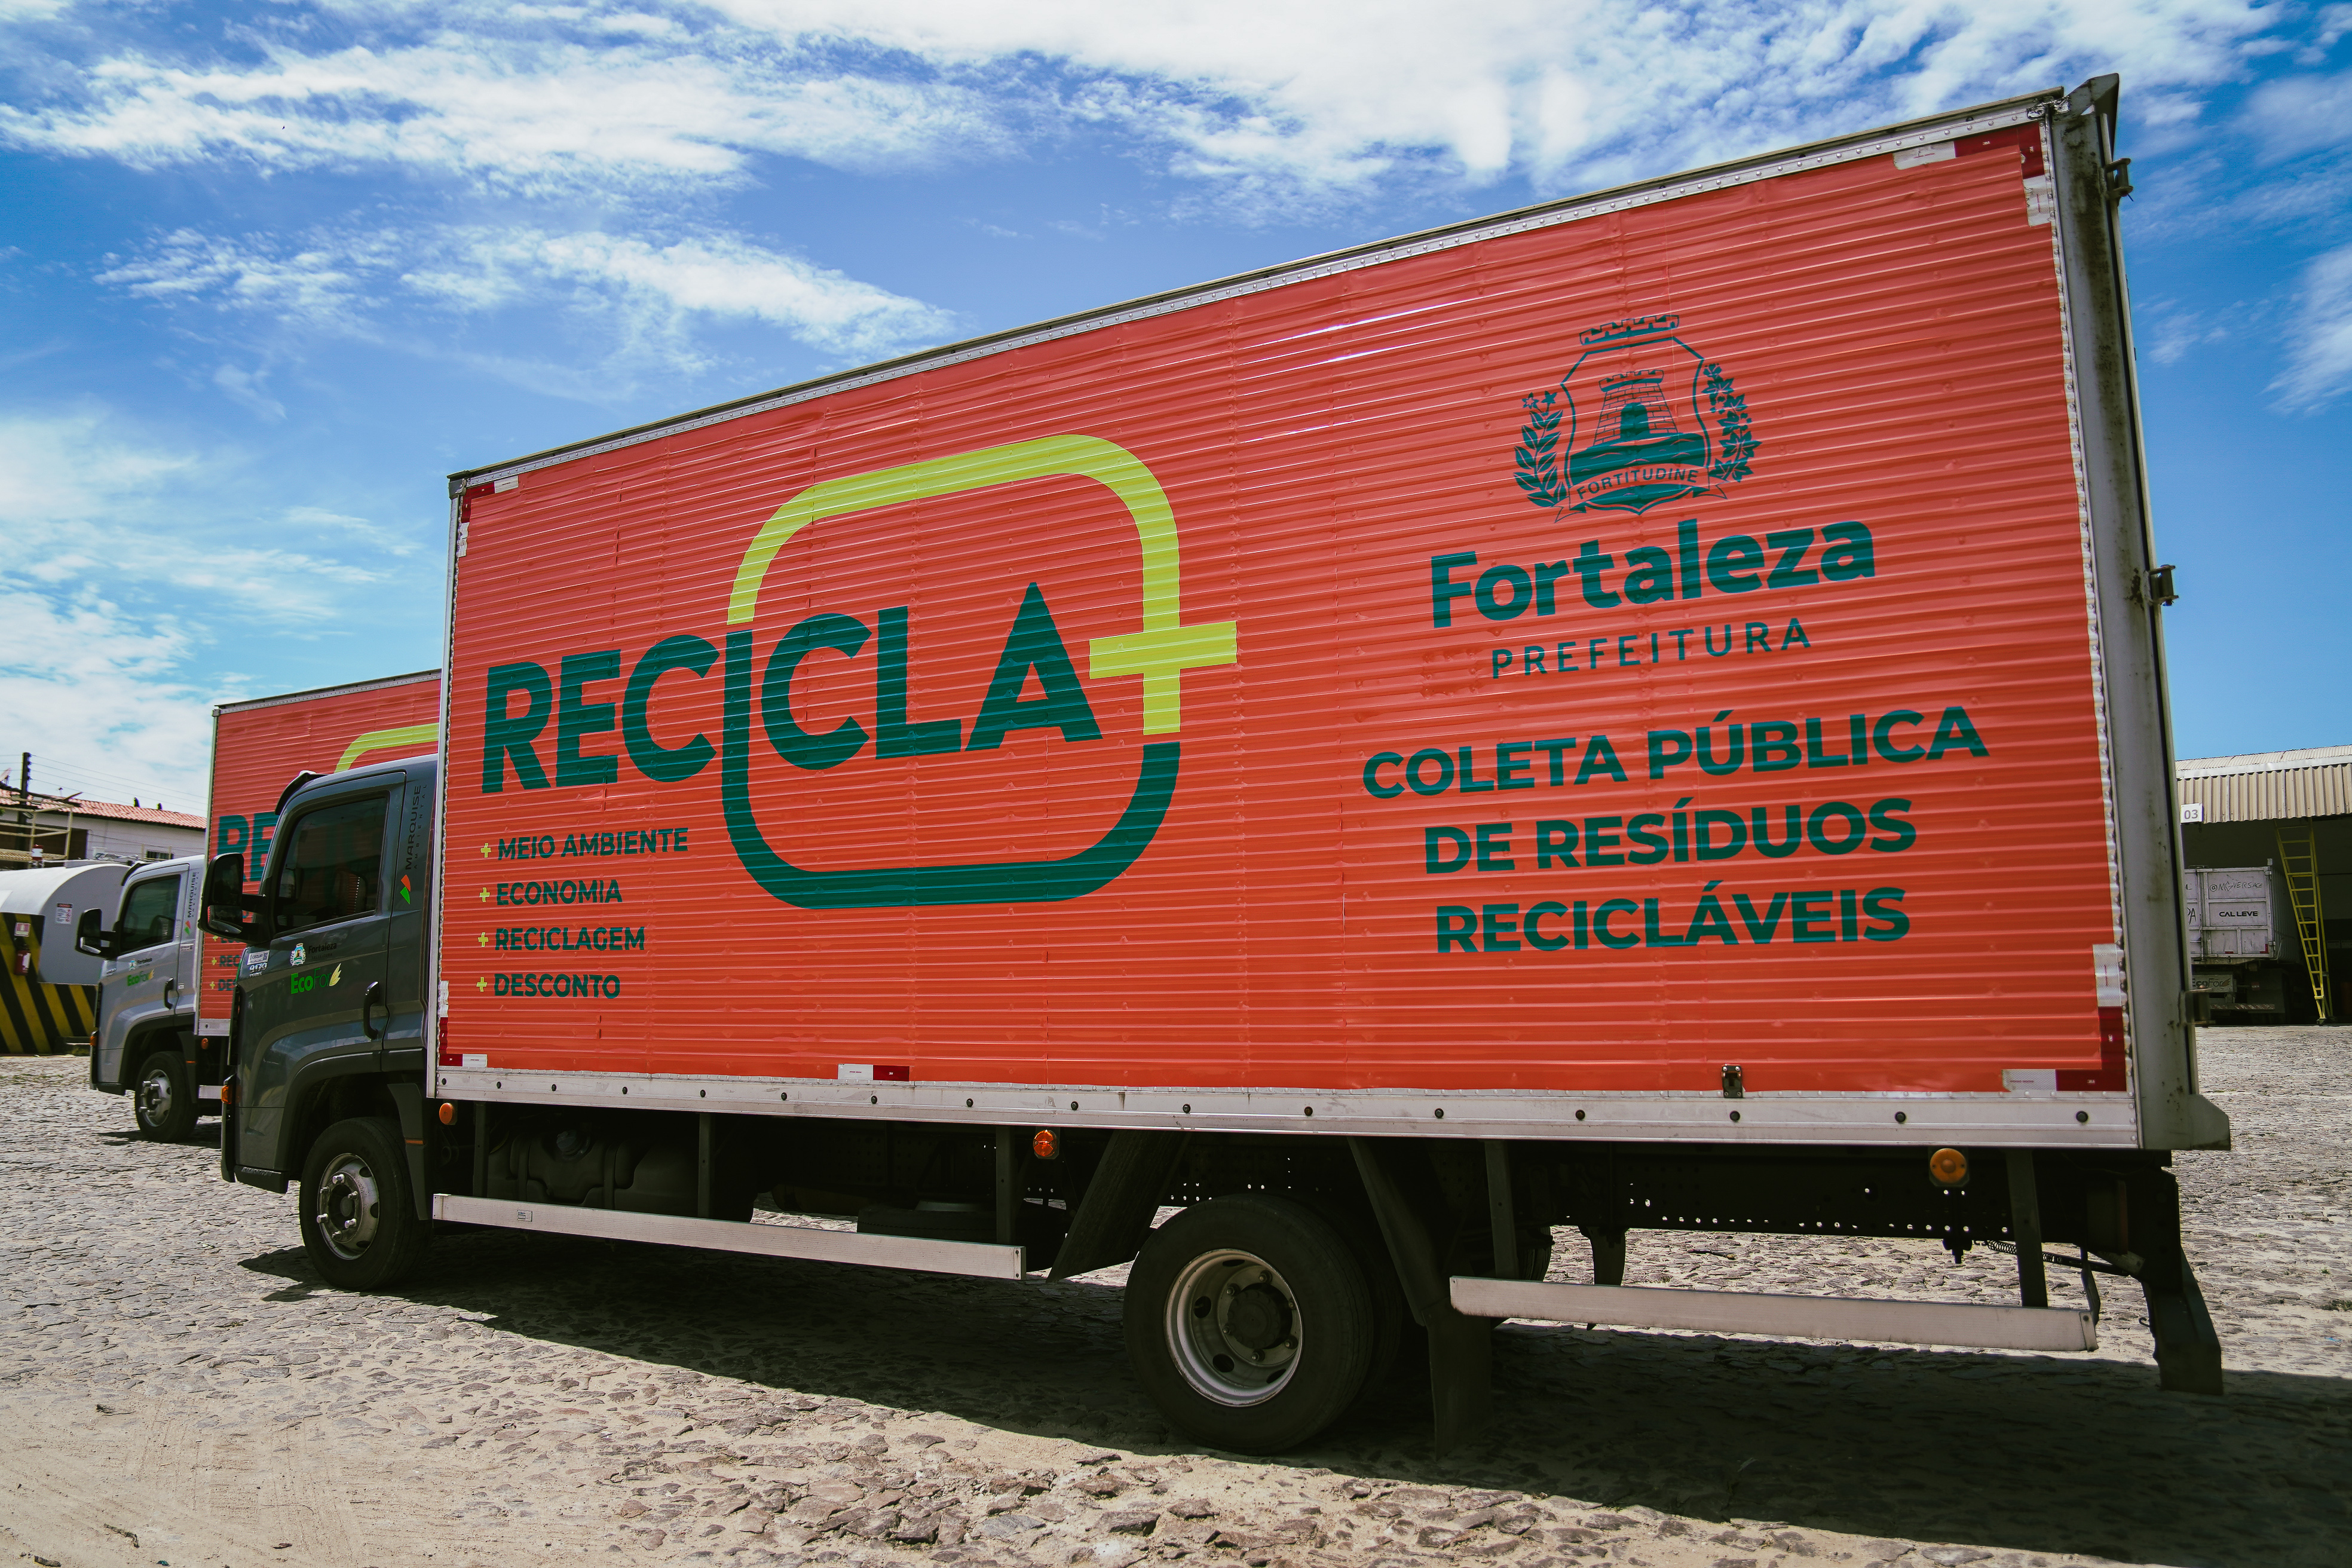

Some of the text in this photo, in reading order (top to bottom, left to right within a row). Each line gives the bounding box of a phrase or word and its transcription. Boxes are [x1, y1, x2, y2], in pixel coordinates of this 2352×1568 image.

[1576, 467, 1699, 500] FORTITUDINE
[1431, 519, 1875, 627] Fortaleza
[1493, 617, 1811, 679] PREFEITURA
[1362, 706, 1990, 799] COLETA PÚBLICA
[405, 785, 421, 869] MARQUISE
[414, 785, 427, 869] AMBIENTAL
[2183, 809, 2198, 819] 03
[498, 835, 555, 860] MEIO
[561, 828, 688, 858] AMBIENTE
[1425, 797, 1916, 874] DE RESÍDUOS
[497, 880, 623, 905] ECONOMIA
[1436, 880, 1910, 953] RECICLÁVEIS
[308, 942, 337, 954] Fortaleza
[495, 927, 645, 951] RECICLAGEM
[290, 967, 332, 994] EcoFor
[494, 973, 620, 999] DESCONTO
